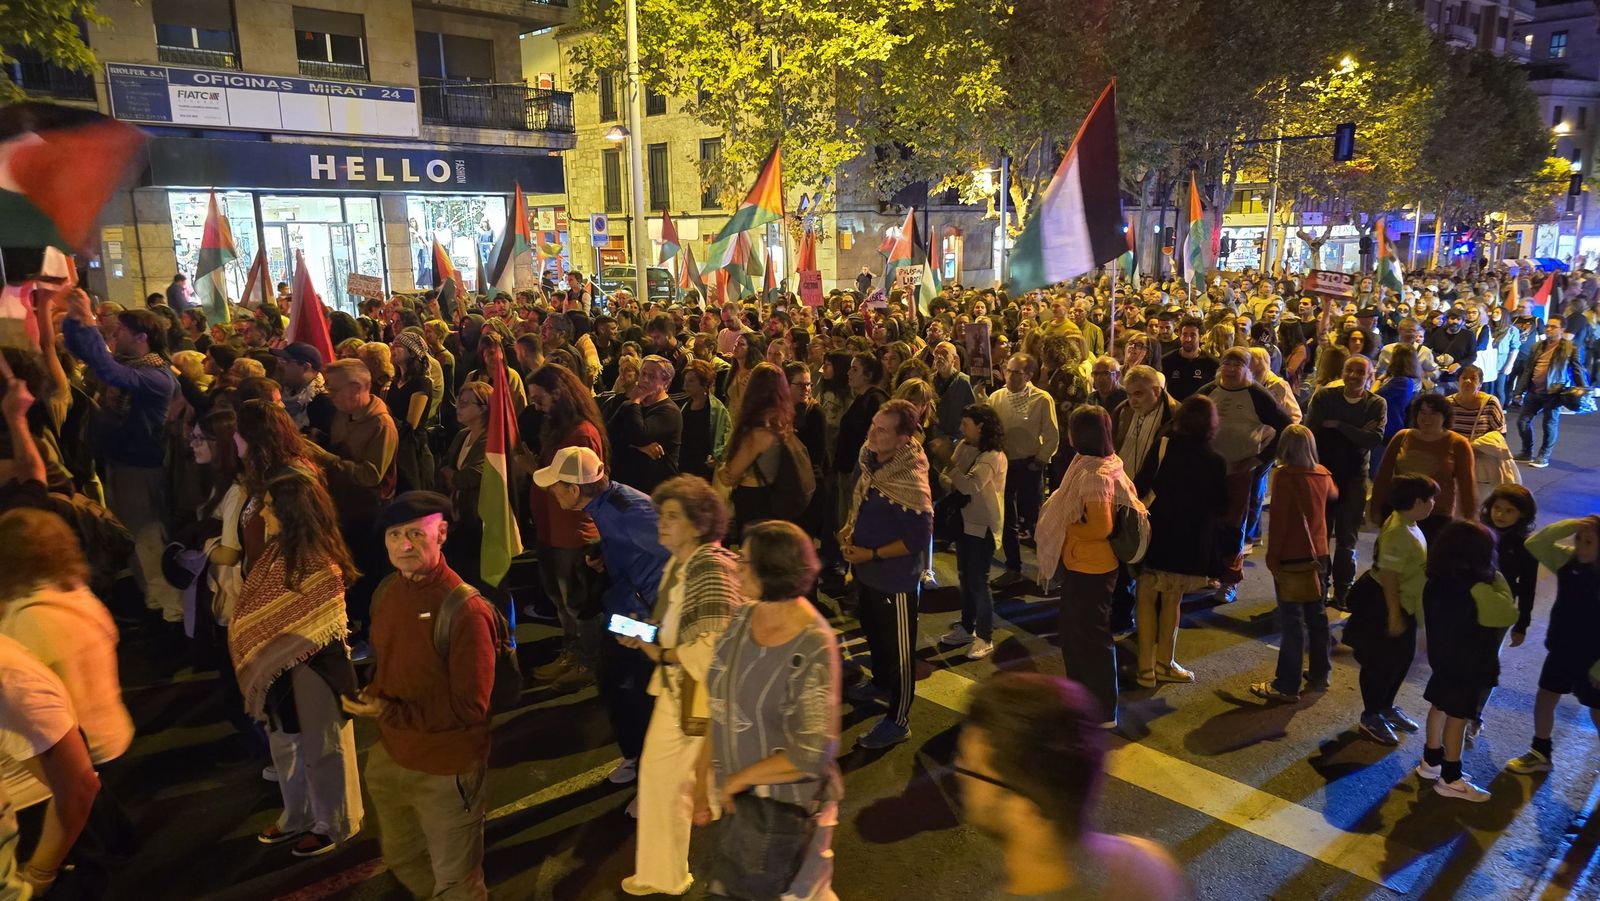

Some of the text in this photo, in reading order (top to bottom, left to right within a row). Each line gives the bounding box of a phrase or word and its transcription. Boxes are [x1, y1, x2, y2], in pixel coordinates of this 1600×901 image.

[177, 90, 209, 100] FIATC
[193, 73, 293, 90] OFICINAS
[381, 89, 401, 99] 24
[310, 154, 451, 183] HELLO
[455, 159, 467, 184] FASHION
[1316, 271, 1351, 285] STOP
